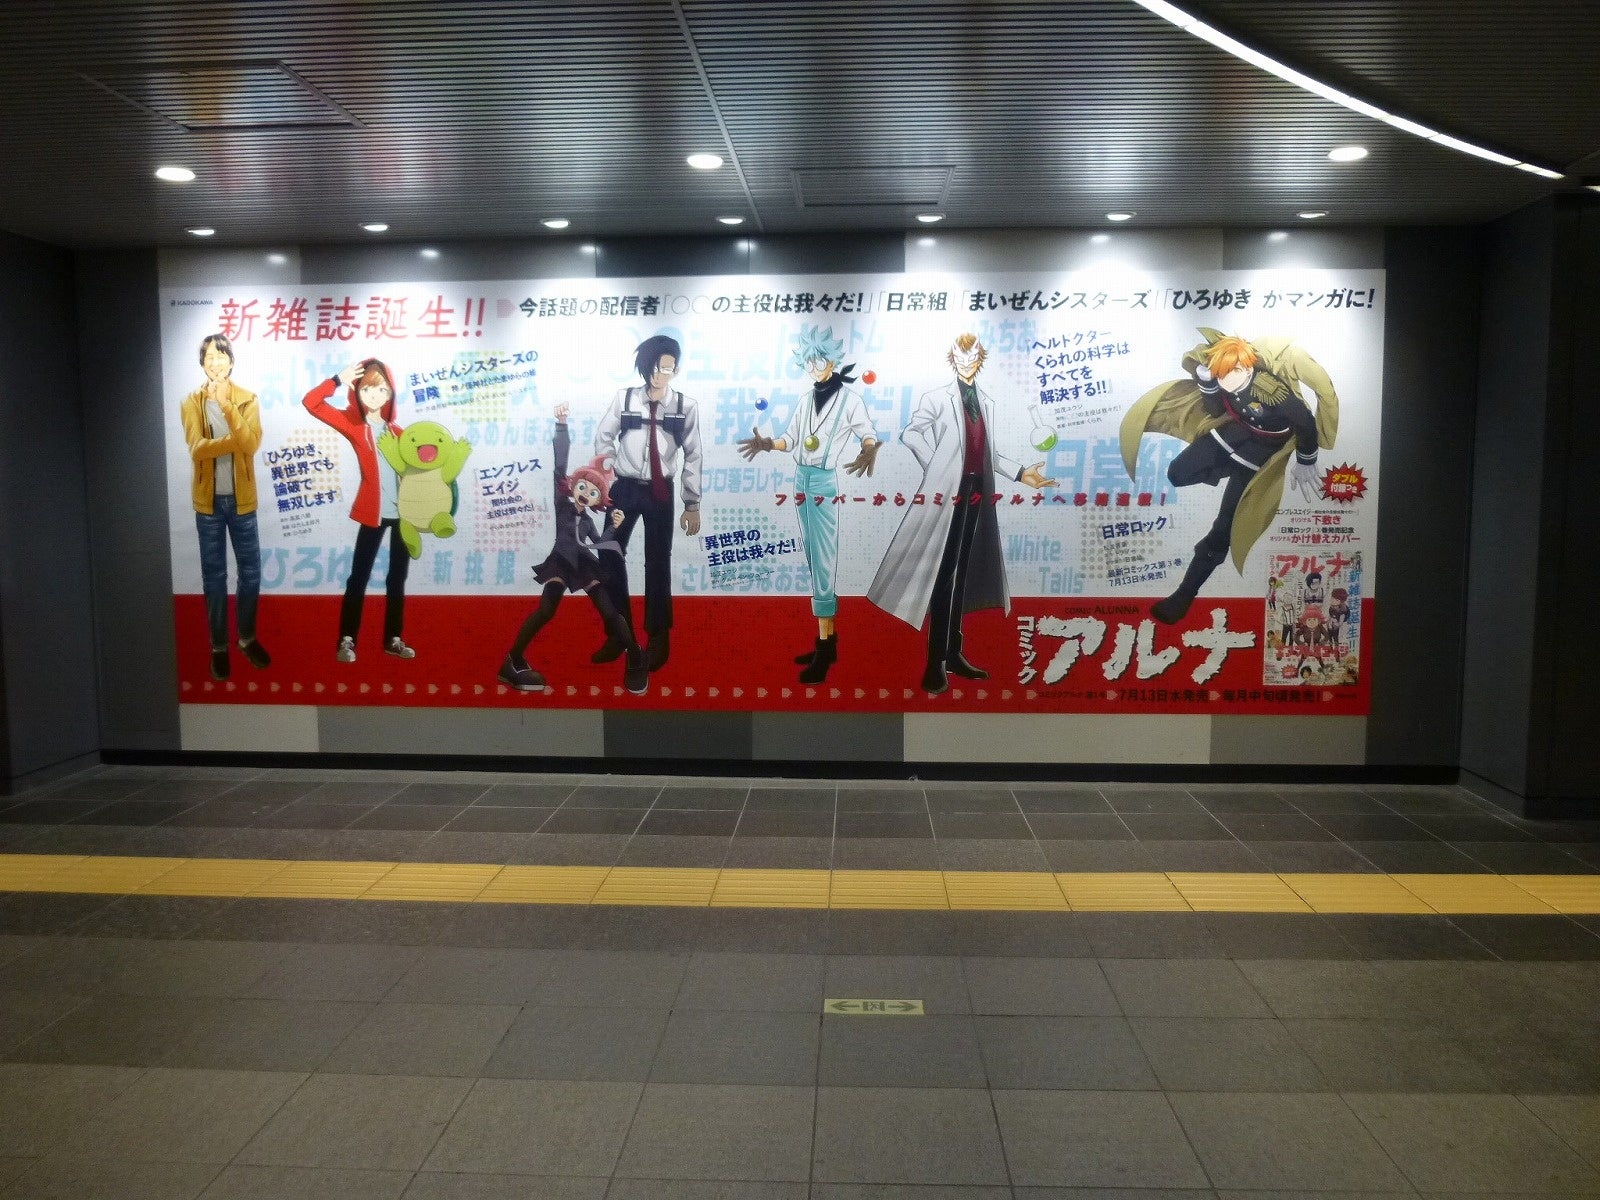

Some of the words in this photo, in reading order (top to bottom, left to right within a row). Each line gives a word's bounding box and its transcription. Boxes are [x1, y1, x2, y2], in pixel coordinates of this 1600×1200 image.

[218, 295, 486, 343] 新雑誌誕生!!
[1035, 341, 1130, 369] くられの科学は
[1036, 365, 1093, 387] すべてを
[271, 457, 334, 480] 異世界でも
[273, 478, 313, 497] 論破で
[482, 478, 519, 496] エイジ
[1008, 535, 1062, 562] White
[1039, 566, 1085, 594] Tails
[1094, 605, 1140, 615] ALUNNA
[1017, 616, 1037, 685] コミック
[1037, 608, 1256, 684] アルナ
